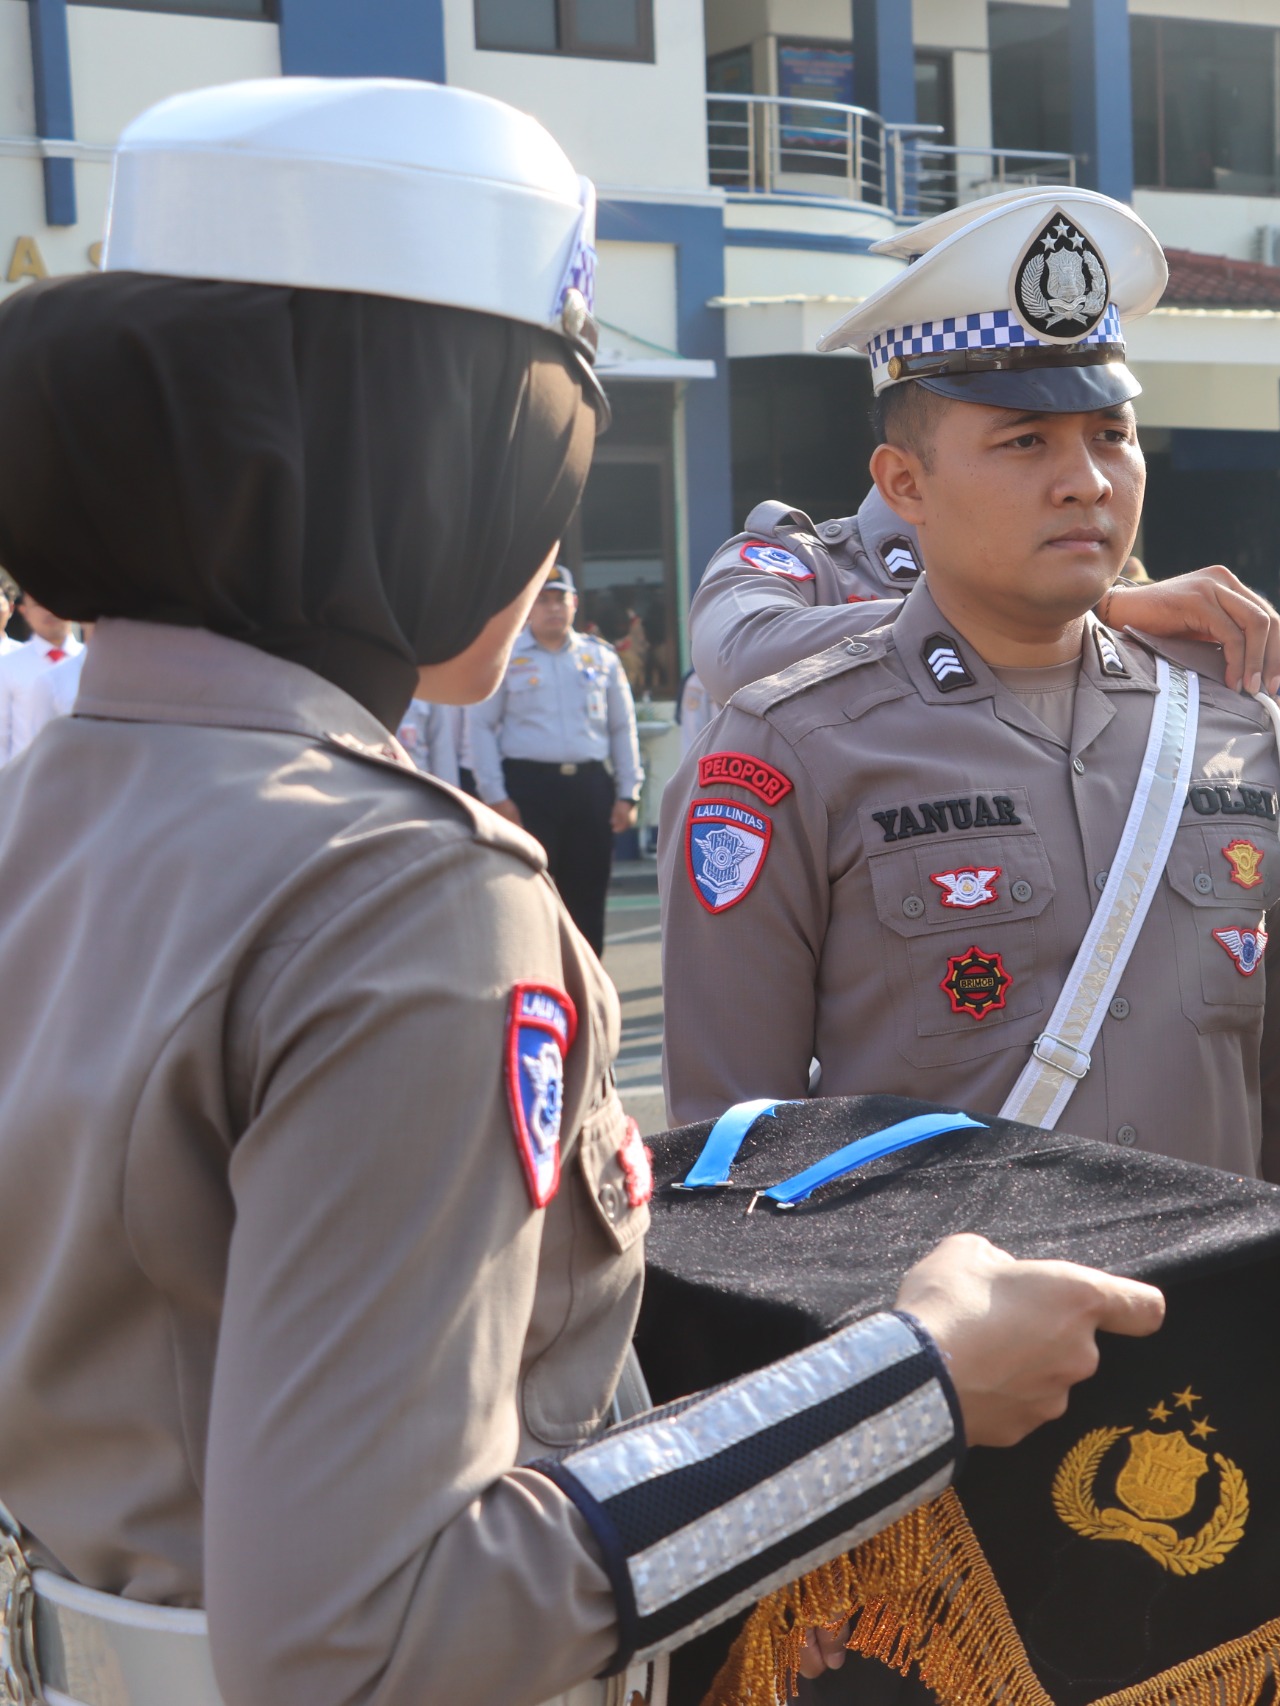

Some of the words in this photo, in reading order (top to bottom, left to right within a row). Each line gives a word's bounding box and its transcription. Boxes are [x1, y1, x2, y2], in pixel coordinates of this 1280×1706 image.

[704, 757, 781, 798] PELOPOR
[696, 804, 723, 817] LALU
[725, 806, 763, 830] LINTAS
[872, 795, 1022, 842] YANUAR
[1184, 784, 1279, 821] OLRI
[961, 977, 994, 988] BRIMOB
